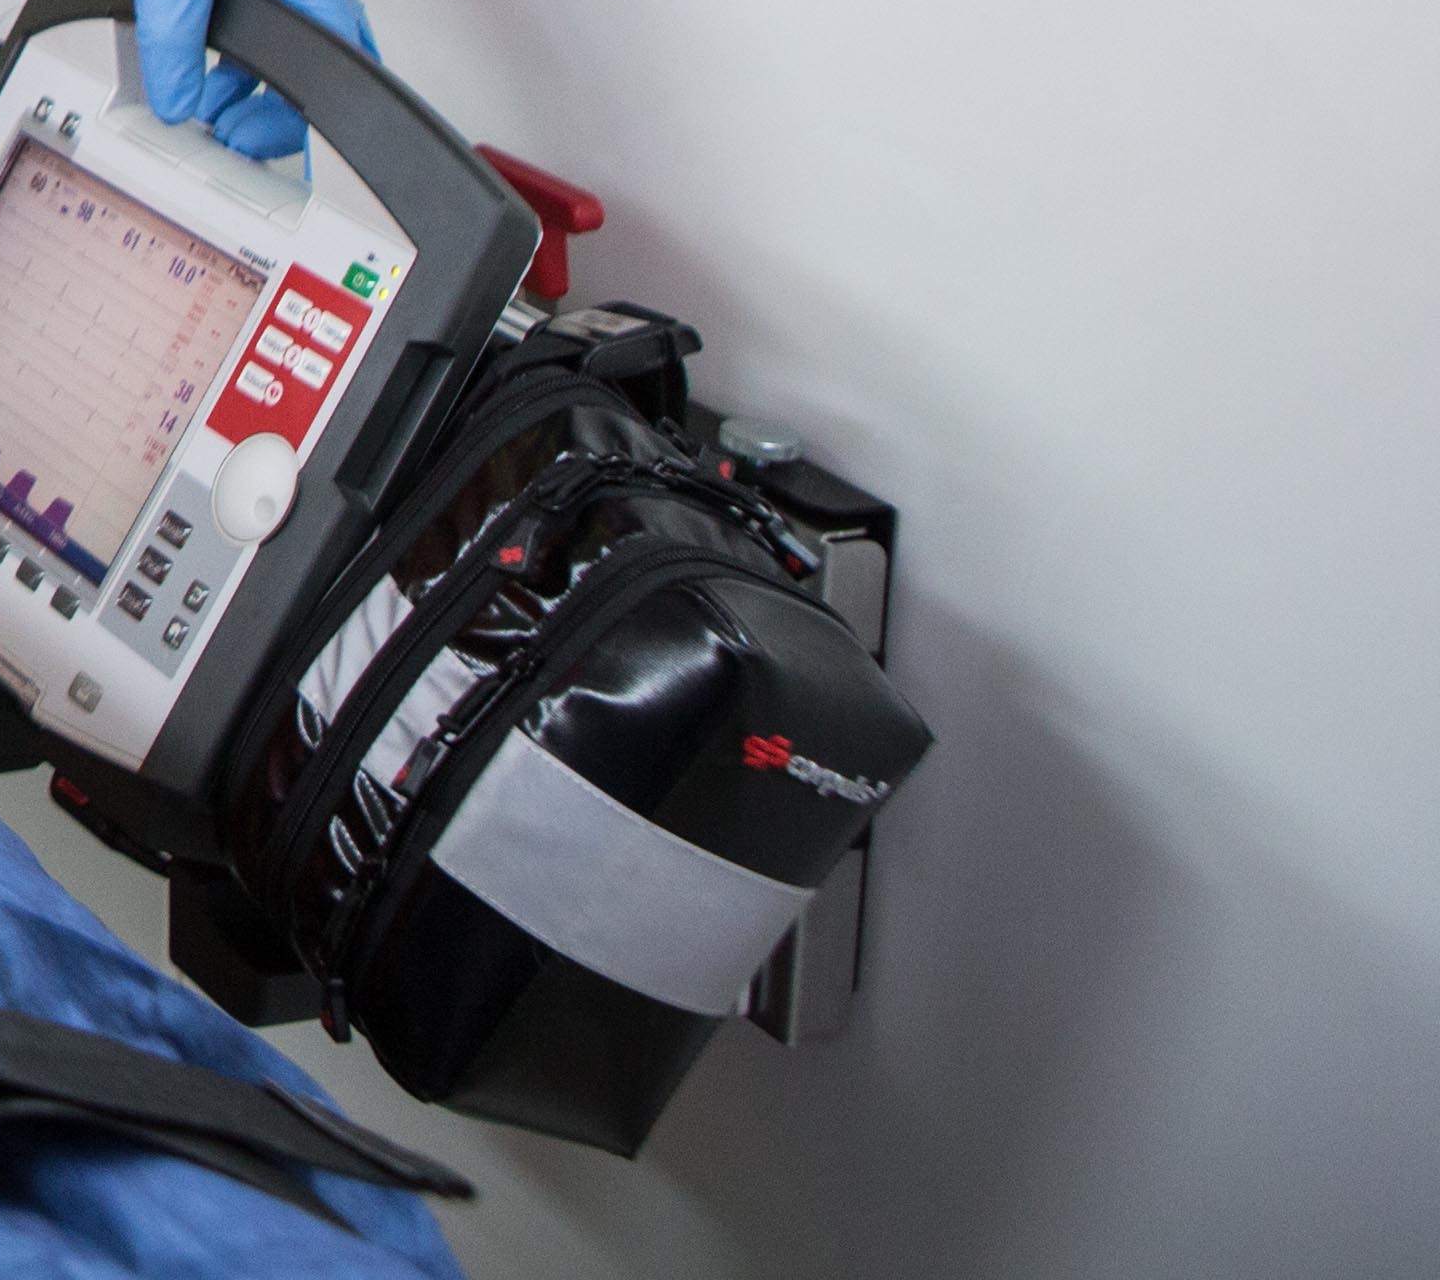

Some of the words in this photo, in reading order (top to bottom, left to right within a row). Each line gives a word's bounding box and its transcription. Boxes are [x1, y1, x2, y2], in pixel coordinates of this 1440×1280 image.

[122, 227, 142, 251] 61
[168, 254, 196, 286] 10.0
[174, 379, 194, 404] 38
[158, 409, 179, 434] 14
